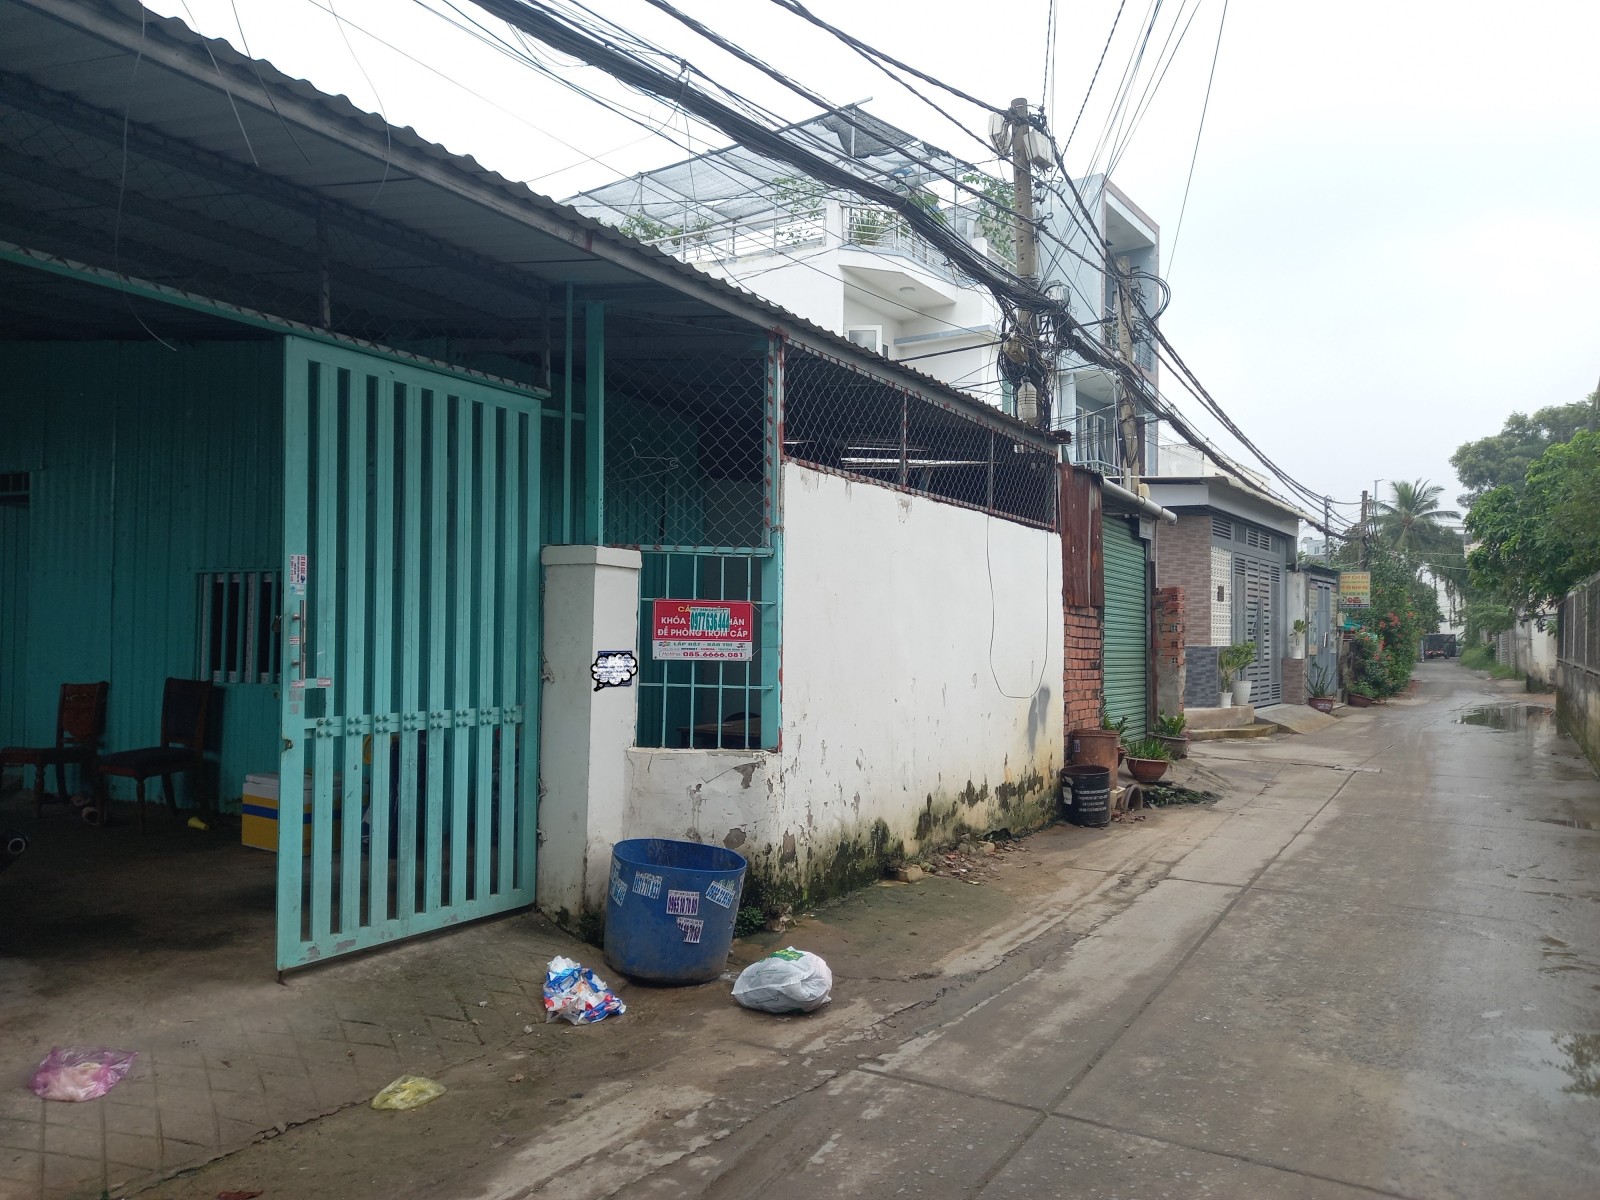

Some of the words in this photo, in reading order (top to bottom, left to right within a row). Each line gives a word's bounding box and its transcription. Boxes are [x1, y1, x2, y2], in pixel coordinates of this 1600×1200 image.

[661, 616, 686, 625] KHÓA
[729, 617, 745, 628] HẬN
[670, 628, 702, 637] PHÒNG
[730, 627, 748, 638] CẮP
